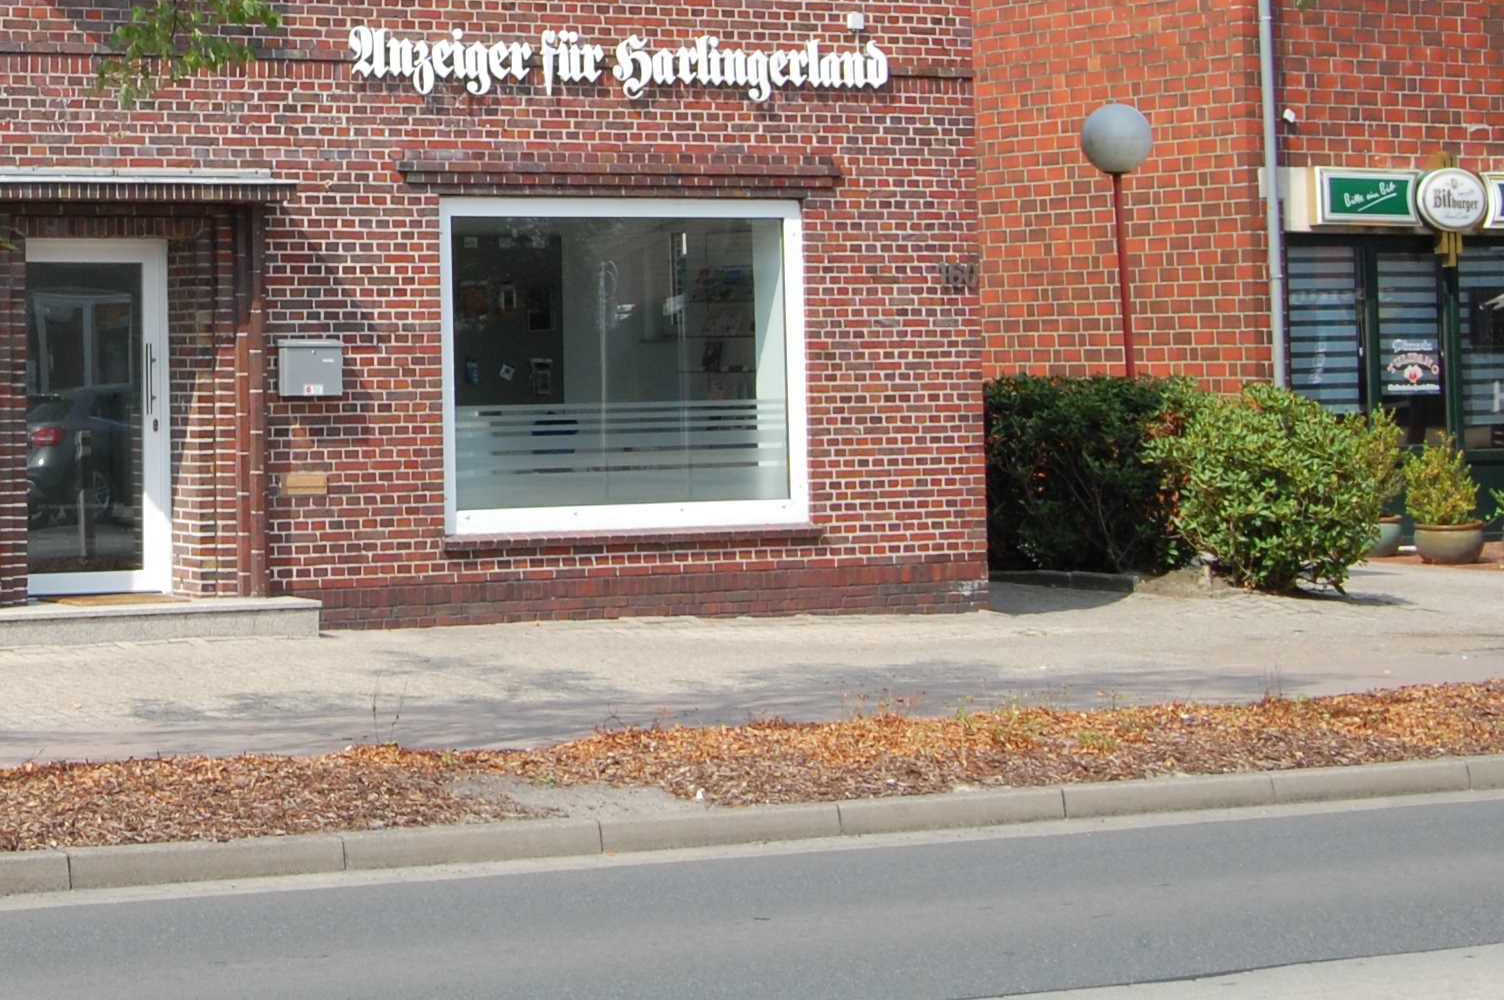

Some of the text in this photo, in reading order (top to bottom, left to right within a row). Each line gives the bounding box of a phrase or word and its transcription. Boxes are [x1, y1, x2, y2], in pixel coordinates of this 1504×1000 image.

[348, 25, 890, 103] Anzeiger für Harlingerland
[1343, 192, 1365, 208] Bitte
[1379, 181, 1397, 195] Bit
[1432, 188, 1479, 213] Bitburger
